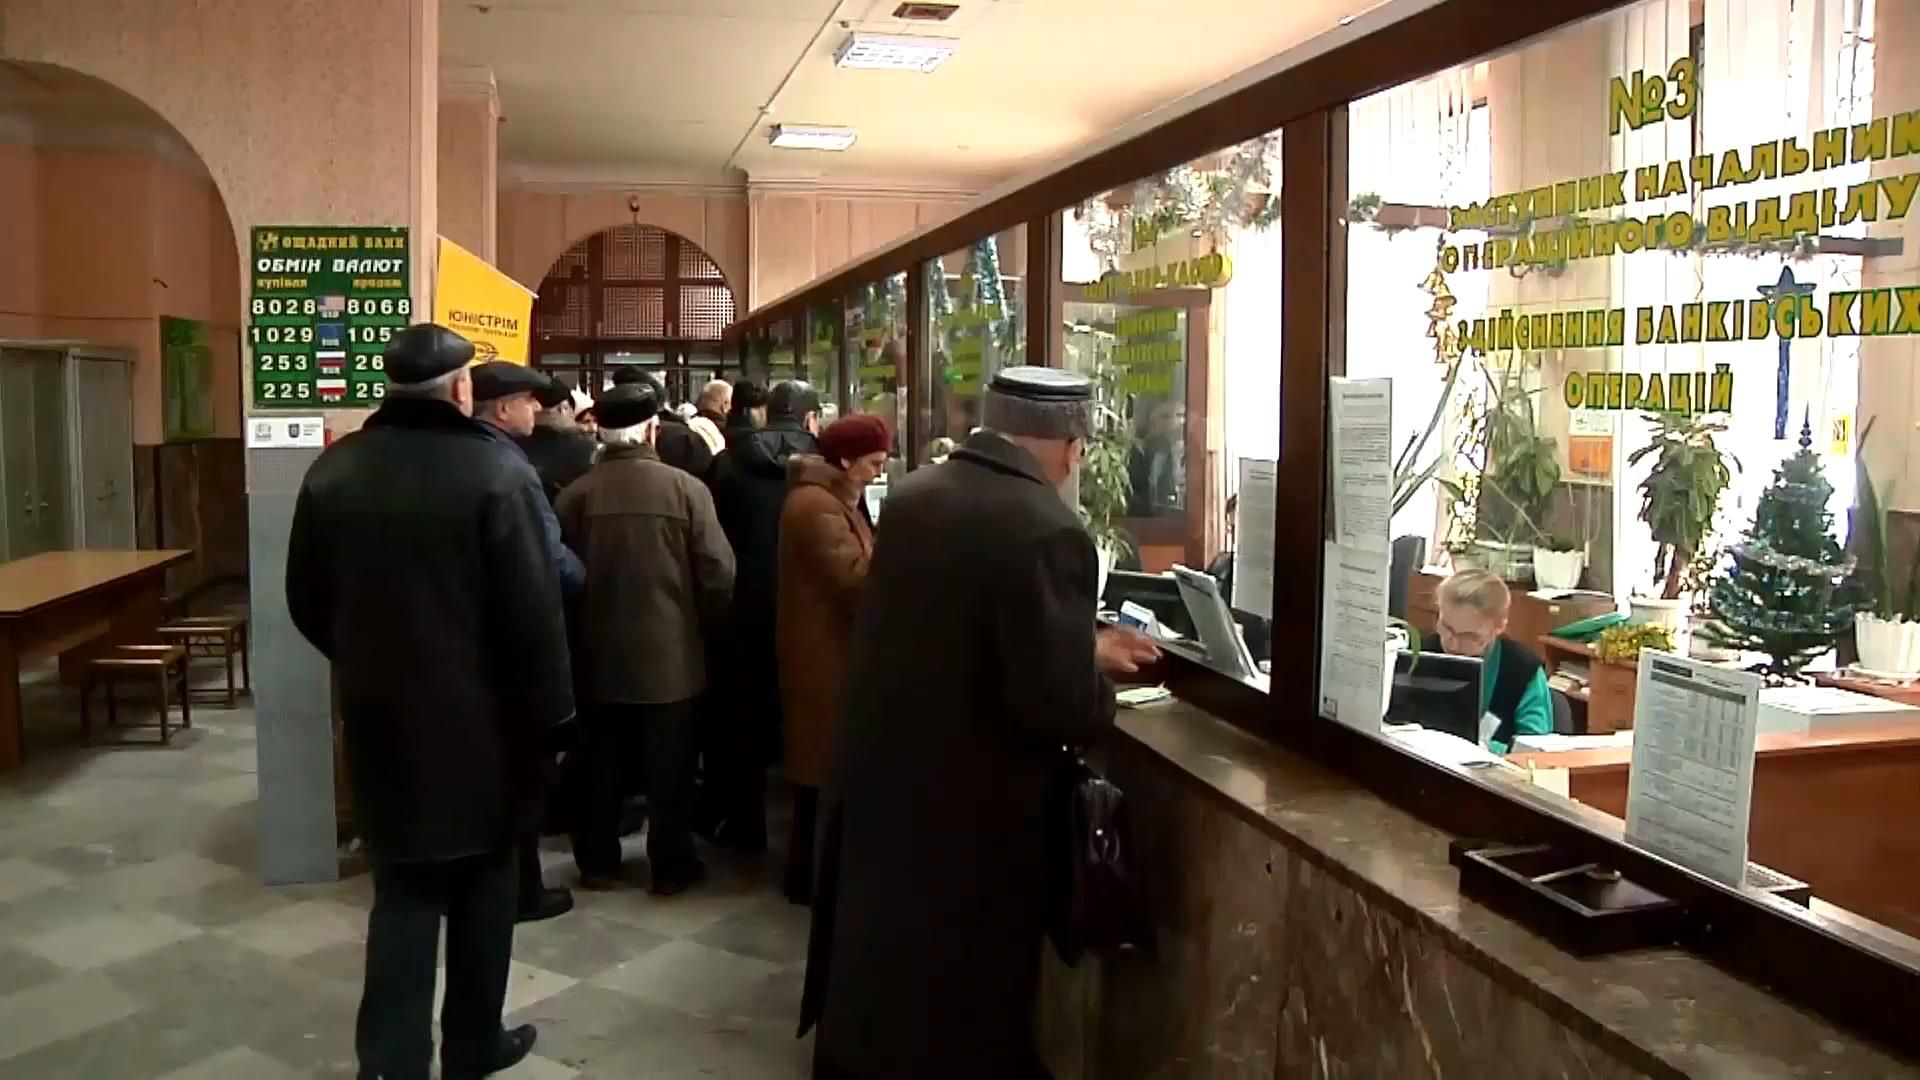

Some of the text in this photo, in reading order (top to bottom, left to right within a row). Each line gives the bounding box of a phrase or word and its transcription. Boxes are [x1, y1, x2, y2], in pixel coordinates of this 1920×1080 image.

[1450, 170, 1628, 232] ЗАСТУПНИК
[1441, 172, 1920, 273] ОПЕРАЦІЙНОГО ВІДДІЛУ
[282, 235, 359, 250] ОЩАДНИЙ
[257, 258, 404, 274] ОБМІН ВАЛЮТ
[252, 299, 316, 315] 8028
[347, 299, 410, 315] 8068
[1457, 285, 1920, 357] ЗДІЙСНЕННЯ БАНКІВСЬКИХ
[252, 327, 314, 343] 1029
[348, 327, 405, 343] 105
[260, 355, 308, 371] 253
[263, 383, 310, 399] 225
[1564, 363, 1734, 417] ОПЕРАЦІЙ
